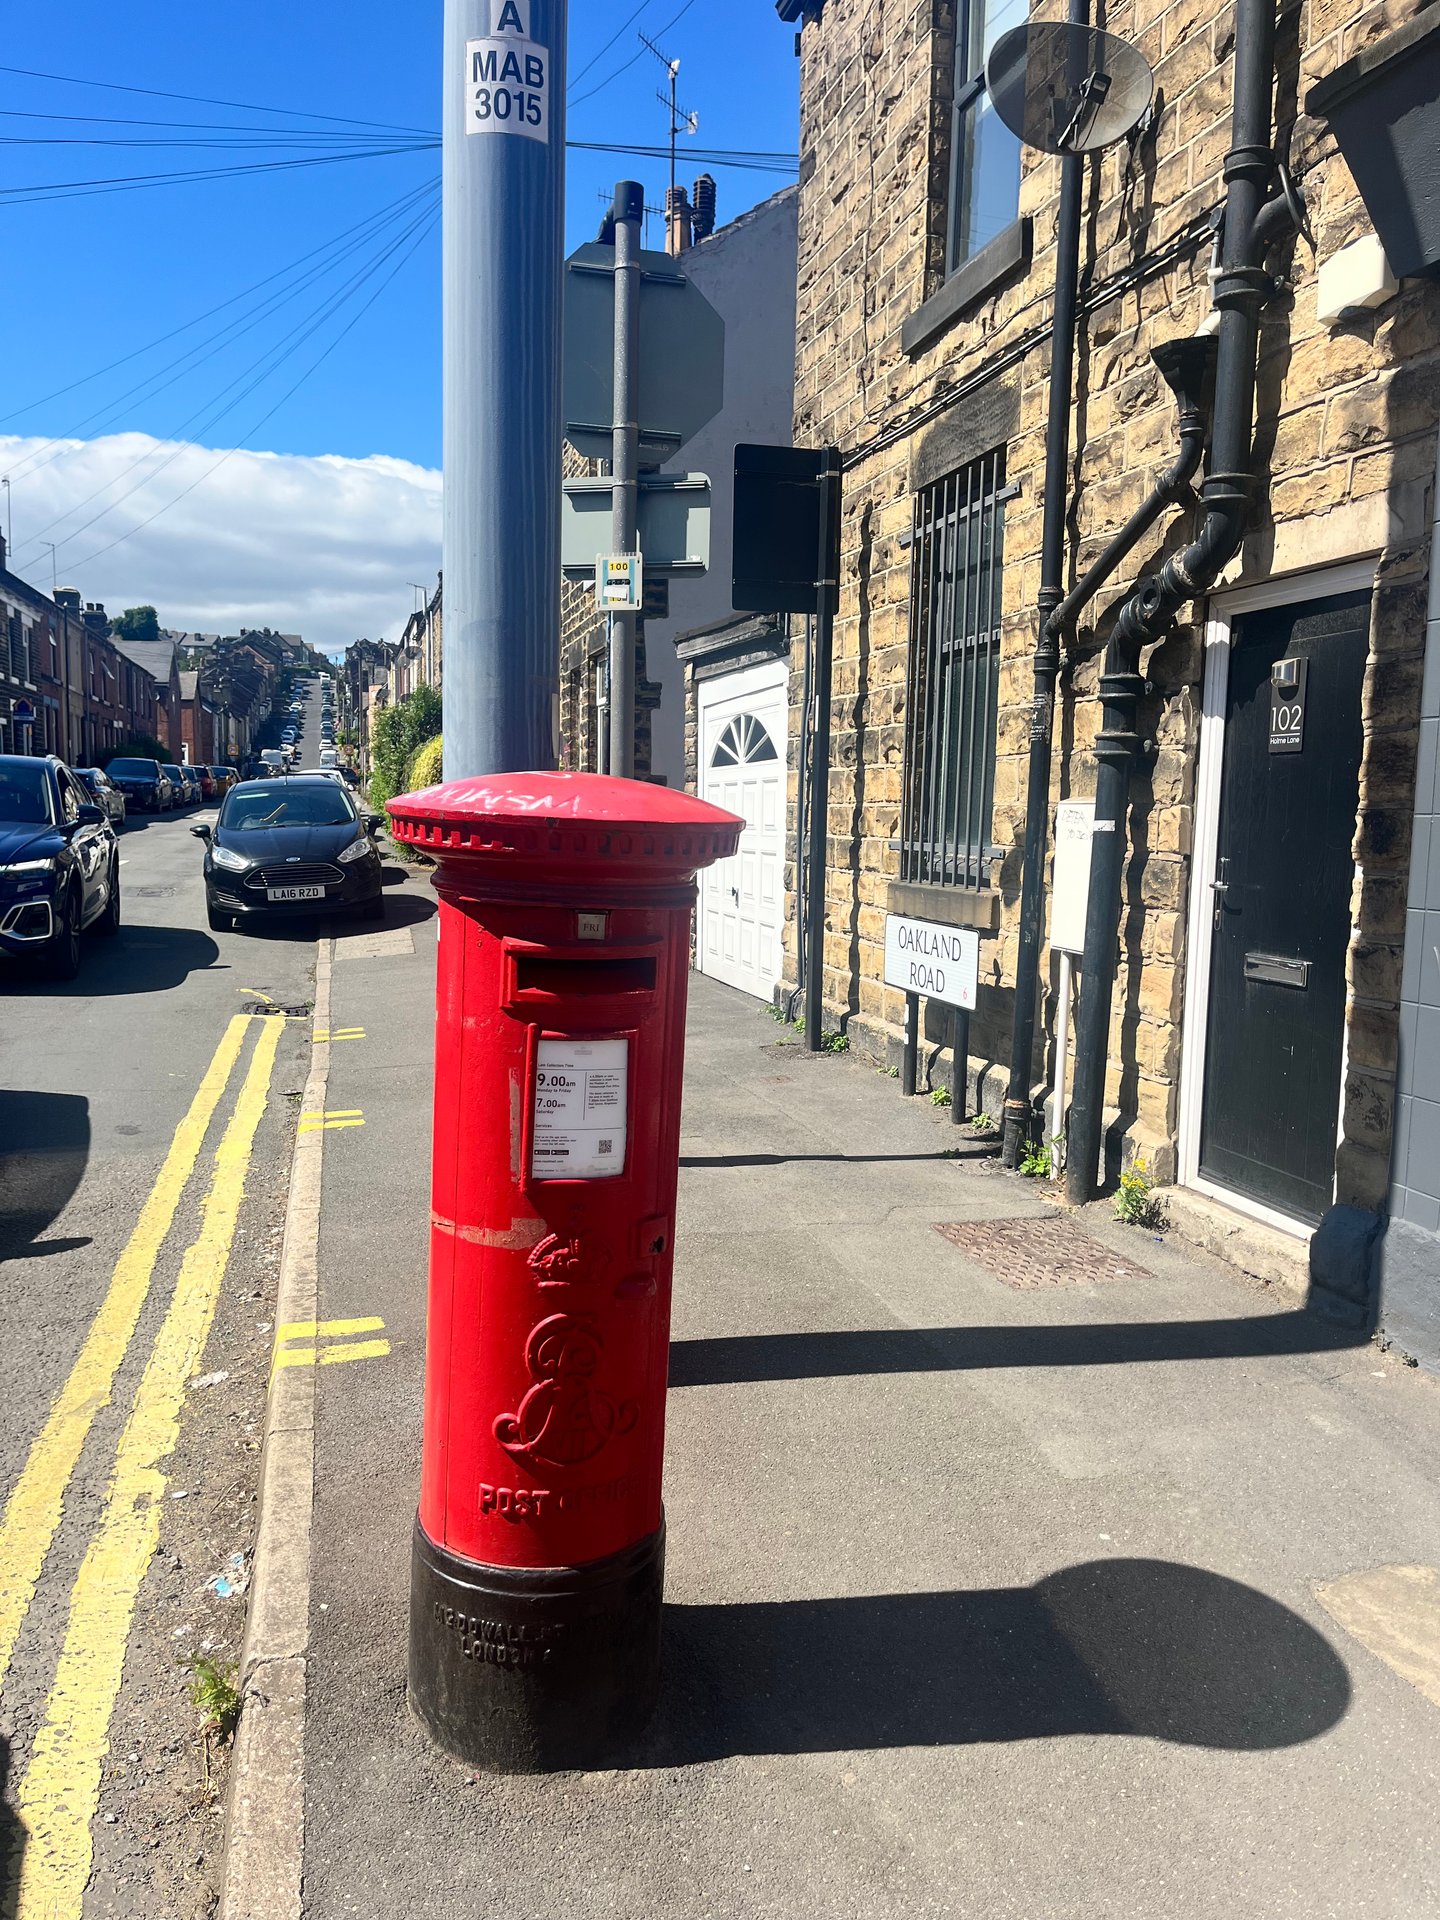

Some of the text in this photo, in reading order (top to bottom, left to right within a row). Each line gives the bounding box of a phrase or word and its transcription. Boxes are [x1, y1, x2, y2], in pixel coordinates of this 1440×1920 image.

[497, 0, 523, 33] A
[473, 50, 544, 88] MAB
[475, 88, 541, 126] 3015
[1272, 705, 1302, 731] 102
[273, 888, 319, 899] LA16 RZD
[583, 923, 600, 932] FRI
[898, 926, 961, 961] OAKLAND
[910, 962, 945, 993] ROAD
[963, 987, 968, 1000] 6
[537, 1073, 576, 1087] 9.00am
[537, 1098, 566, 1108] 7.00am
[478, 1483, 549, 1515] POST
